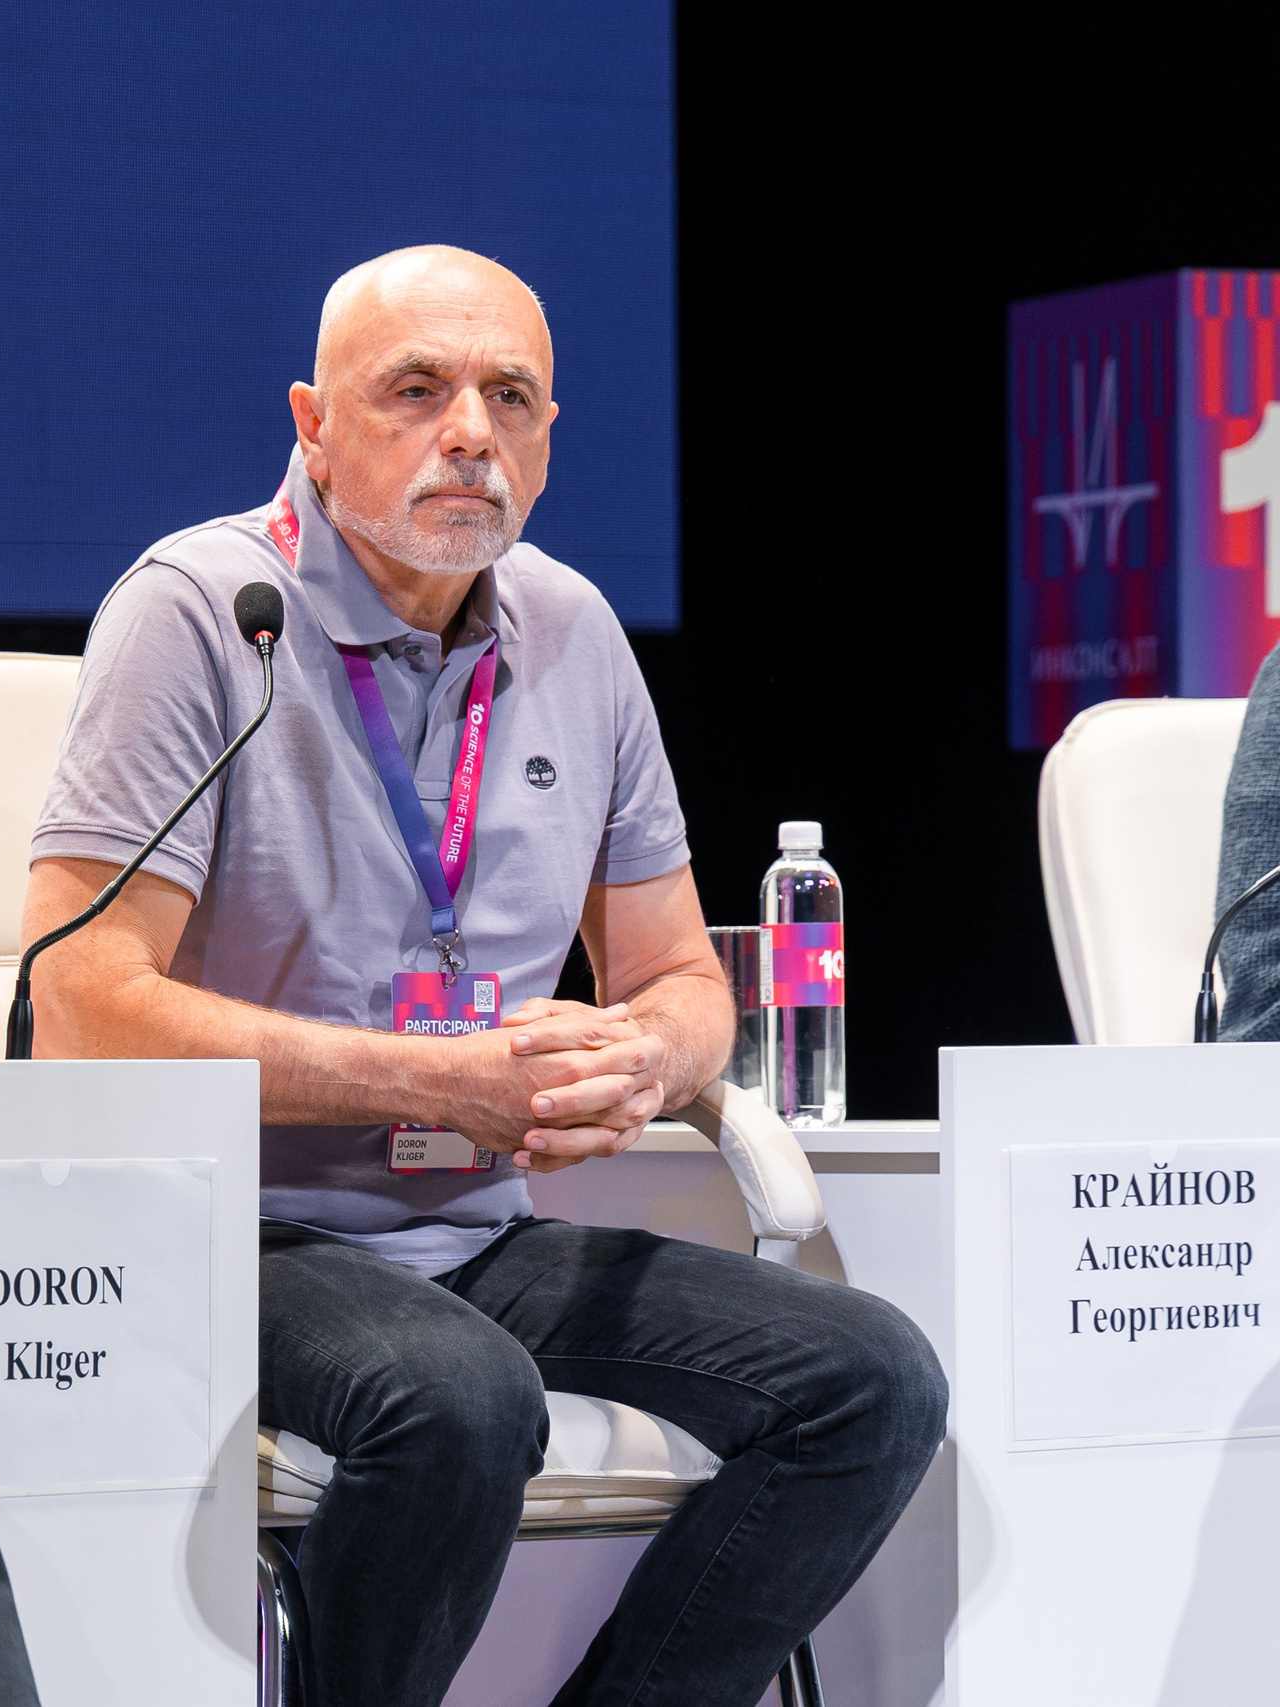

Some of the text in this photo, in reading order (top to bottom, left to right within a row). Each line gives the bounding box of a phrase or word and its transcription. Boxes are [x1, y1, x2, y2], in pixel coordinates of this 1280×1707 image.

[446, 703, 485, 864] 10 SCIENCE OF THE FUTURE
[405, 1020, 489, 1035] PARTICIPANT
[396, 1152, 425, 1161] KLIGER
[397, 1139, 427, 1149] DORON
[1071, 1162, 1256, 1209] КРАЙНОВ
[1075, 1236, 1253, 1276] Александр
[1069, 1299, 1261, 1342] Георгиевич
[4, 1340, 107, 1390] Kliger
